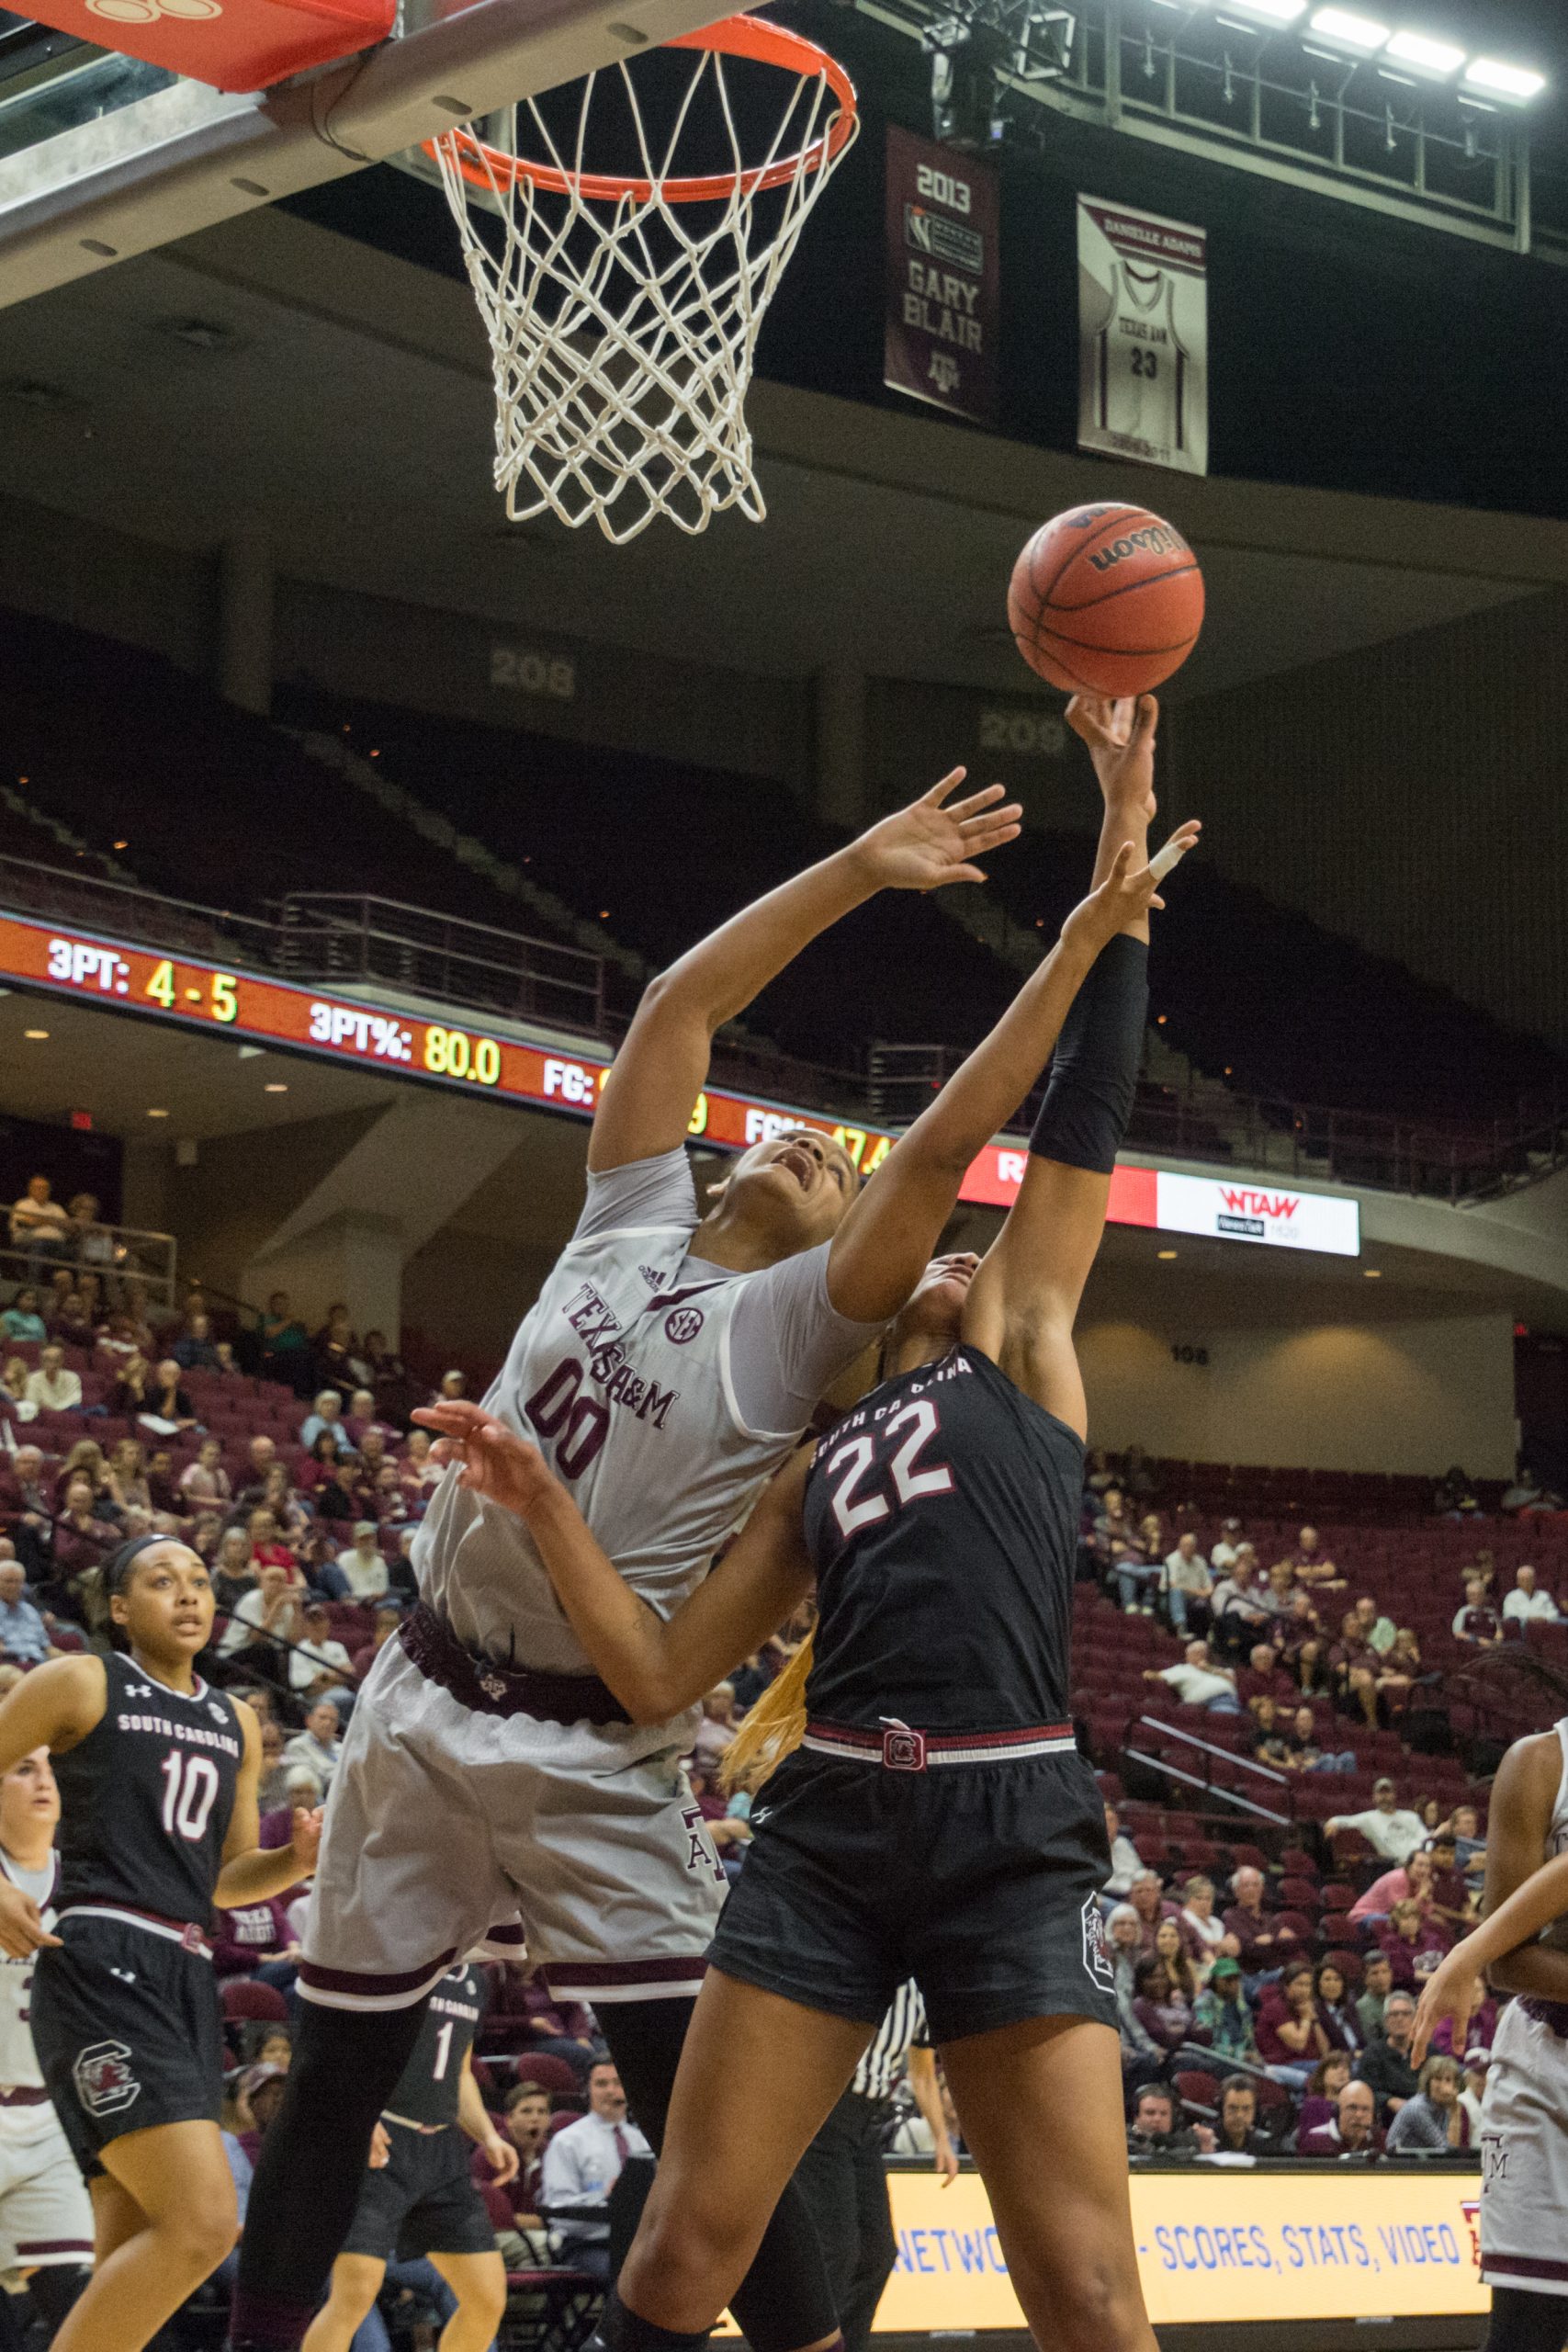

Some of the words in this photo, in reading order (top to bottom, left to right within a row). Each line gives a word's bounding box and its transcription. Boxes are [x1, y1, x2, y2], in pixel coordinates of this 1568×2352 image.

[917, 164, 971, 214] 2013
[908, 259, 979, 314] GARY
[903, 292, 982, 355] BLAIR
[1131, 345, 1157, 379] 23
[491, 648, 575, 697] 208
[48, 938, 130, 994] 3PT:
[146, 959, 175, 1008] 4
[210, 972, 238, 1022] 5
[310, 1001, 412, 1062] 3PT%:
[423, 1025, 501, 1085] 80.0
[543, 1058, 594, 1106] FG:
[1218, 1186, 1301, 1219] WTAW
[525, 1357, 611, 1480] 00
[605, 1363, 681, 1430] A&M
[826, 1397, 954, 1540] 22
[117, 1714, 173, 1736] SOUTH
[174, 1724, 240, 1758] CAROLINA
[161, 1748, 220, 1841] 10
[433, 2021, 454, 2080] 1
[892, 2227, 1010, 2274] NETWO
[1155, 2223, 1282, 2276] SCORES,
[1281, 2223, 1381, 2274] STATS,
[1377, 2222, 1461, 2266] VIDEO
